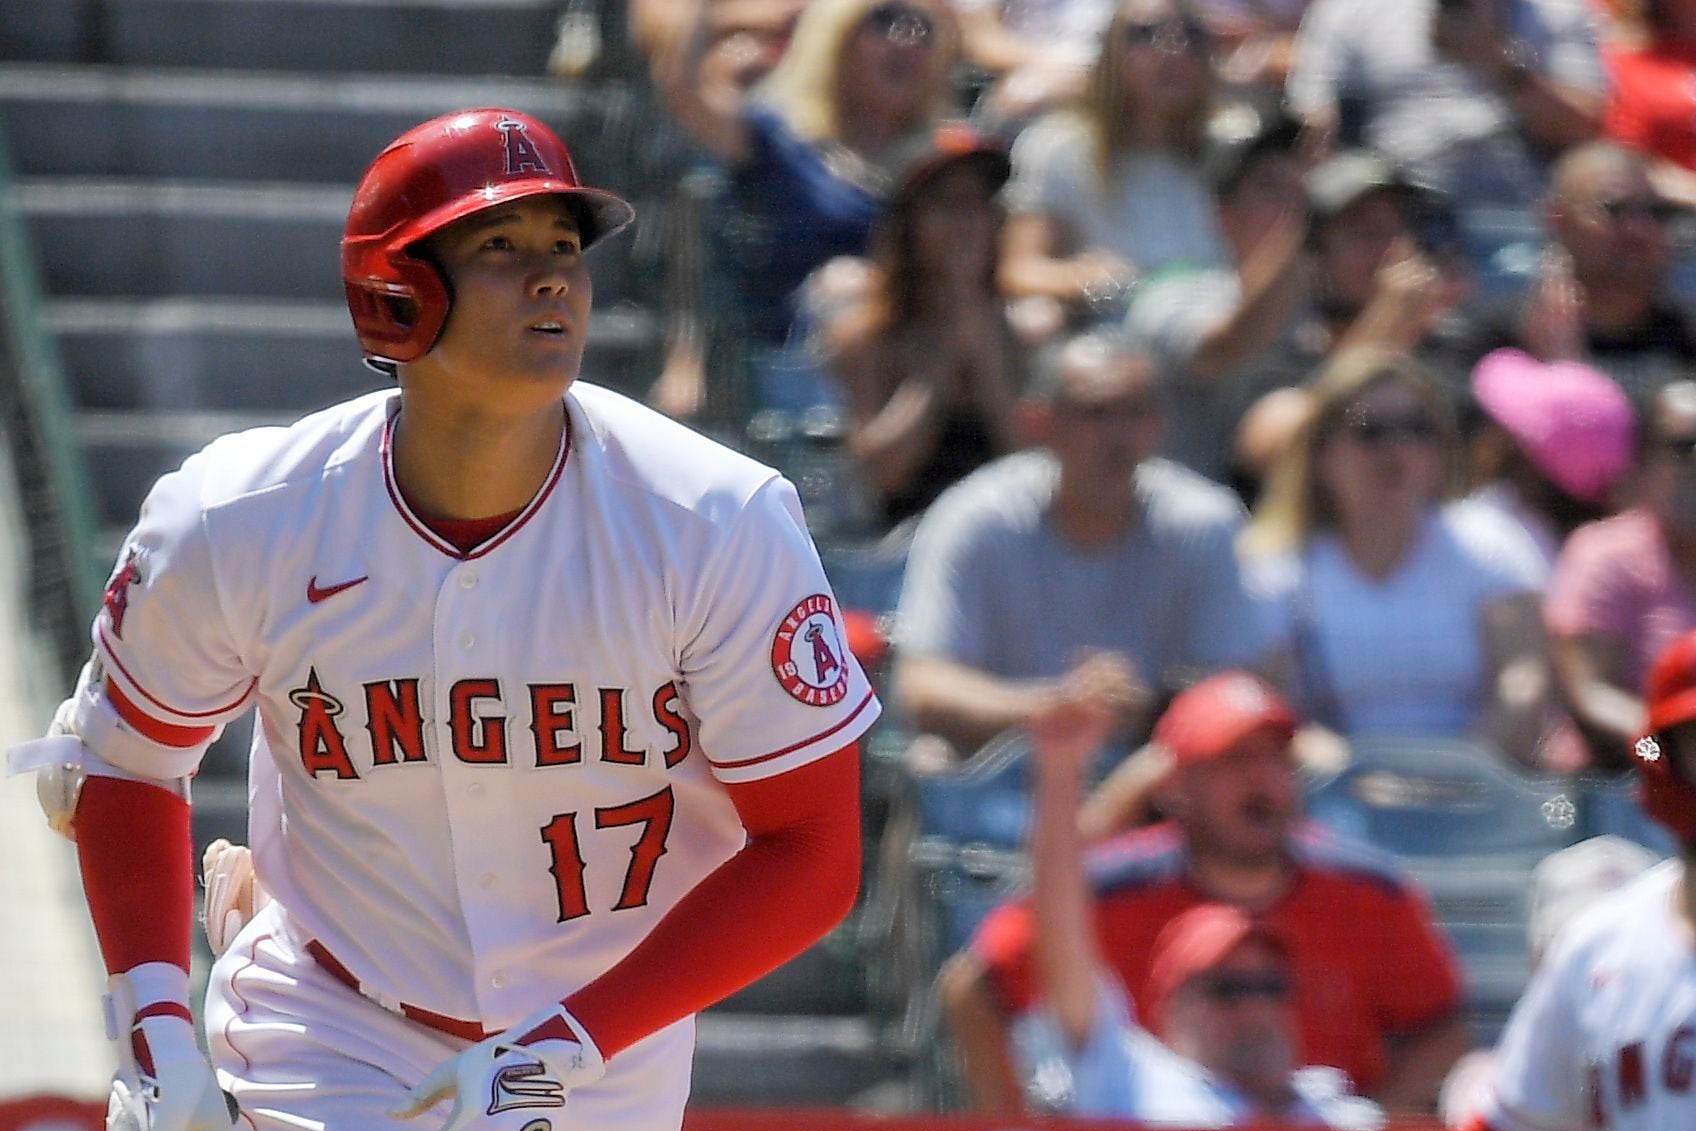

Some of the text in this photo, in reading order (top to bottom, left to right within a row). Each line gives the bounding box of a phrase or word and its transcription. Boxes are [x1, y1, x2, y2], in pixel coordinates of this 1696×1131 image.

[495, 114, 551, 175] A
[804, 620, 839, 685] A
[289, 666, 694, 781] ANGELS
[541, 785, 677, 924] 17
